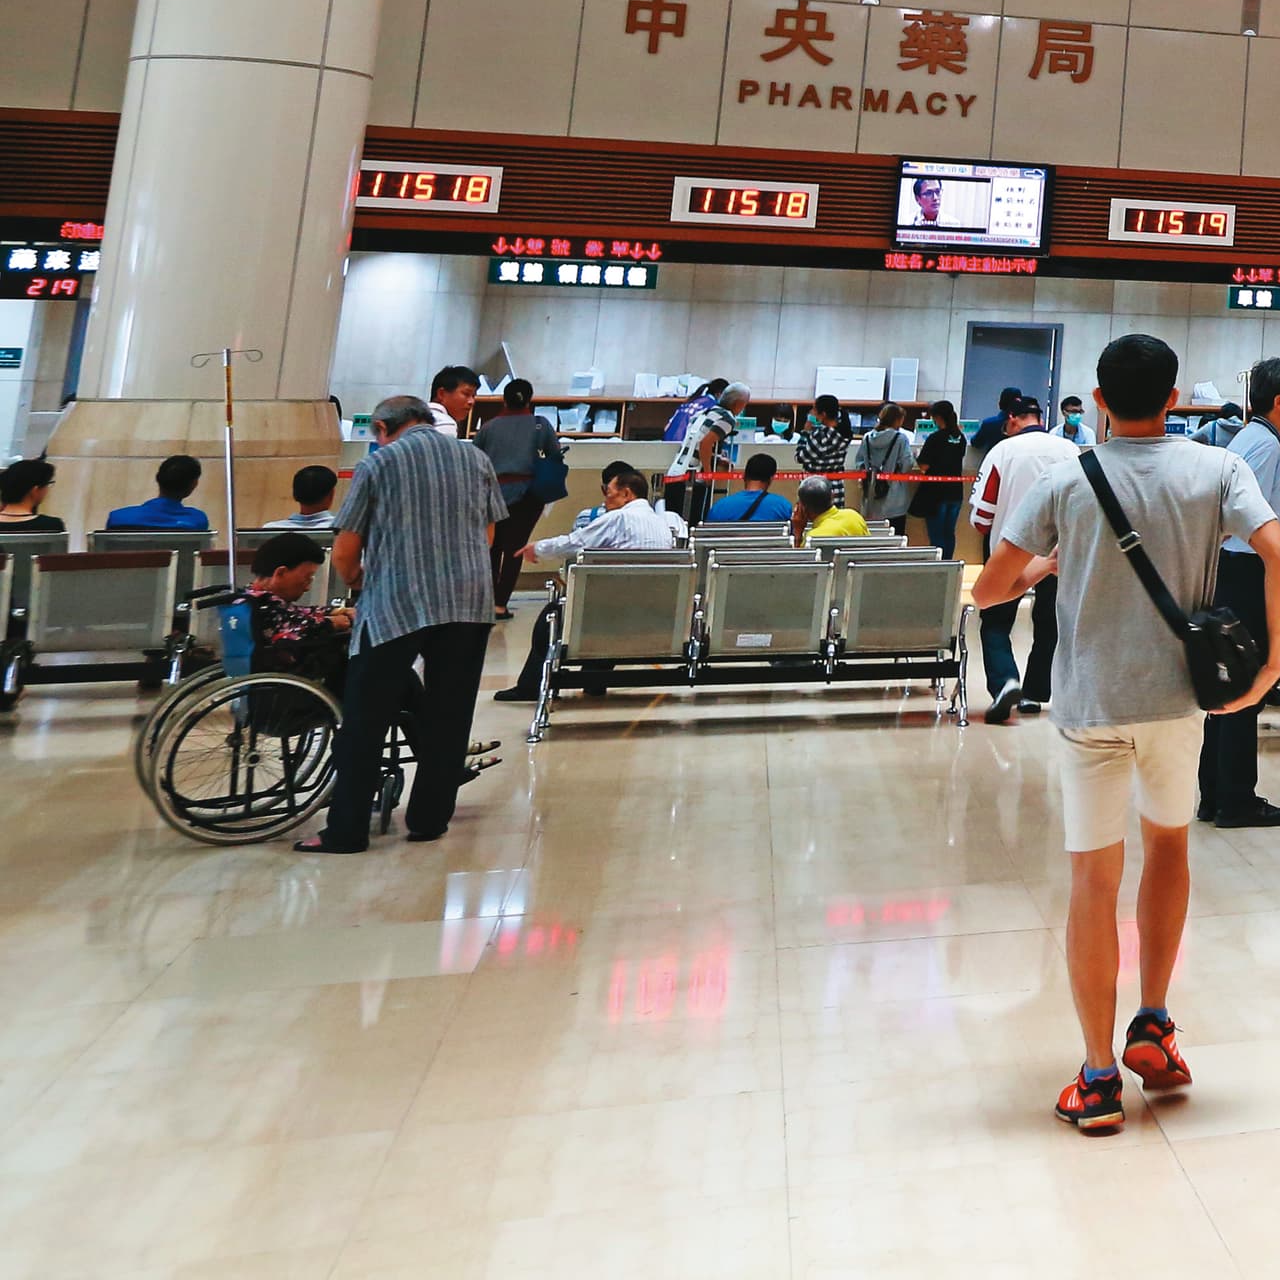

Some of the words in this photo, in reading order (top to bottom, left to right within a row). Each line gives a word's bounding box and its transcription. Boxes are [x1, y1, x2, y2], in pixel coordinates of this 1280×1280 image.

[738, 79, 978, 118] PHARMACY
[703, 188, 807, 217] 11518
[1136, 211, 1226, 236] 11519
